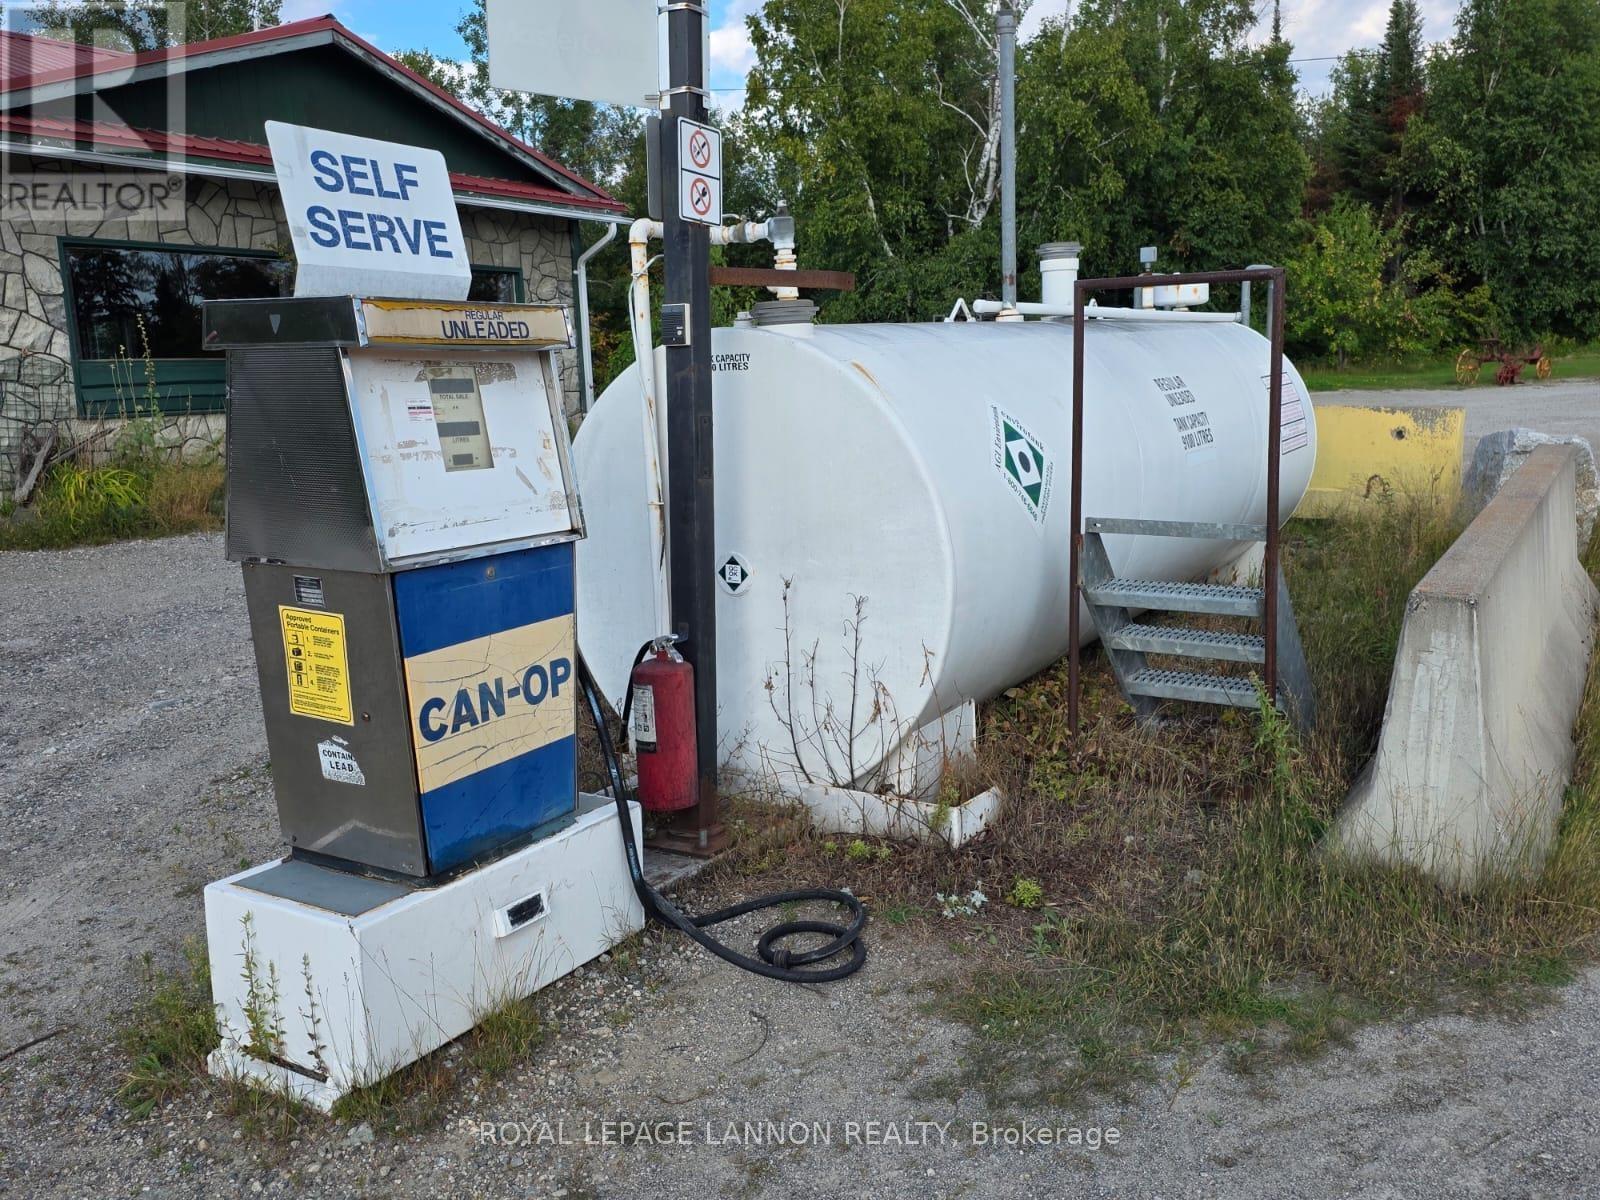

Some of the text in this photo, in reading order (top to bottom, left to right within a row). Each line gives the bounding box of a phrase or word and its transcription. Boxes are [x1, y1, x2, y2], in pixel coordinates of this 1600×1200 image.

[311, 151, 419, 201] SELF
[307, 206, 454, 259] SERVE
[465, 310, 504, 321] REGULAR
[441, 320, 530, 339] UNLEADED
[715, 353, 751, 362] CAPACITY
[719, 362, 749, 371] LITRES
[1153, 375, 1188, 392] REGULAR
[1164, 390, 1196, 407] UNLEADED
[1173, 411, 1210, 432] TANK CAPACITY
[1194, 427, 1214, 446] LITRES
[286, 613, 312, 623] Approved
[287, 620, 340, 635] Portable Containers
[418, 658, 570, 742] CAN-OP
[322, 749, 355, 761] CONTAIN
[329, 760, 354, 772] LEAD
